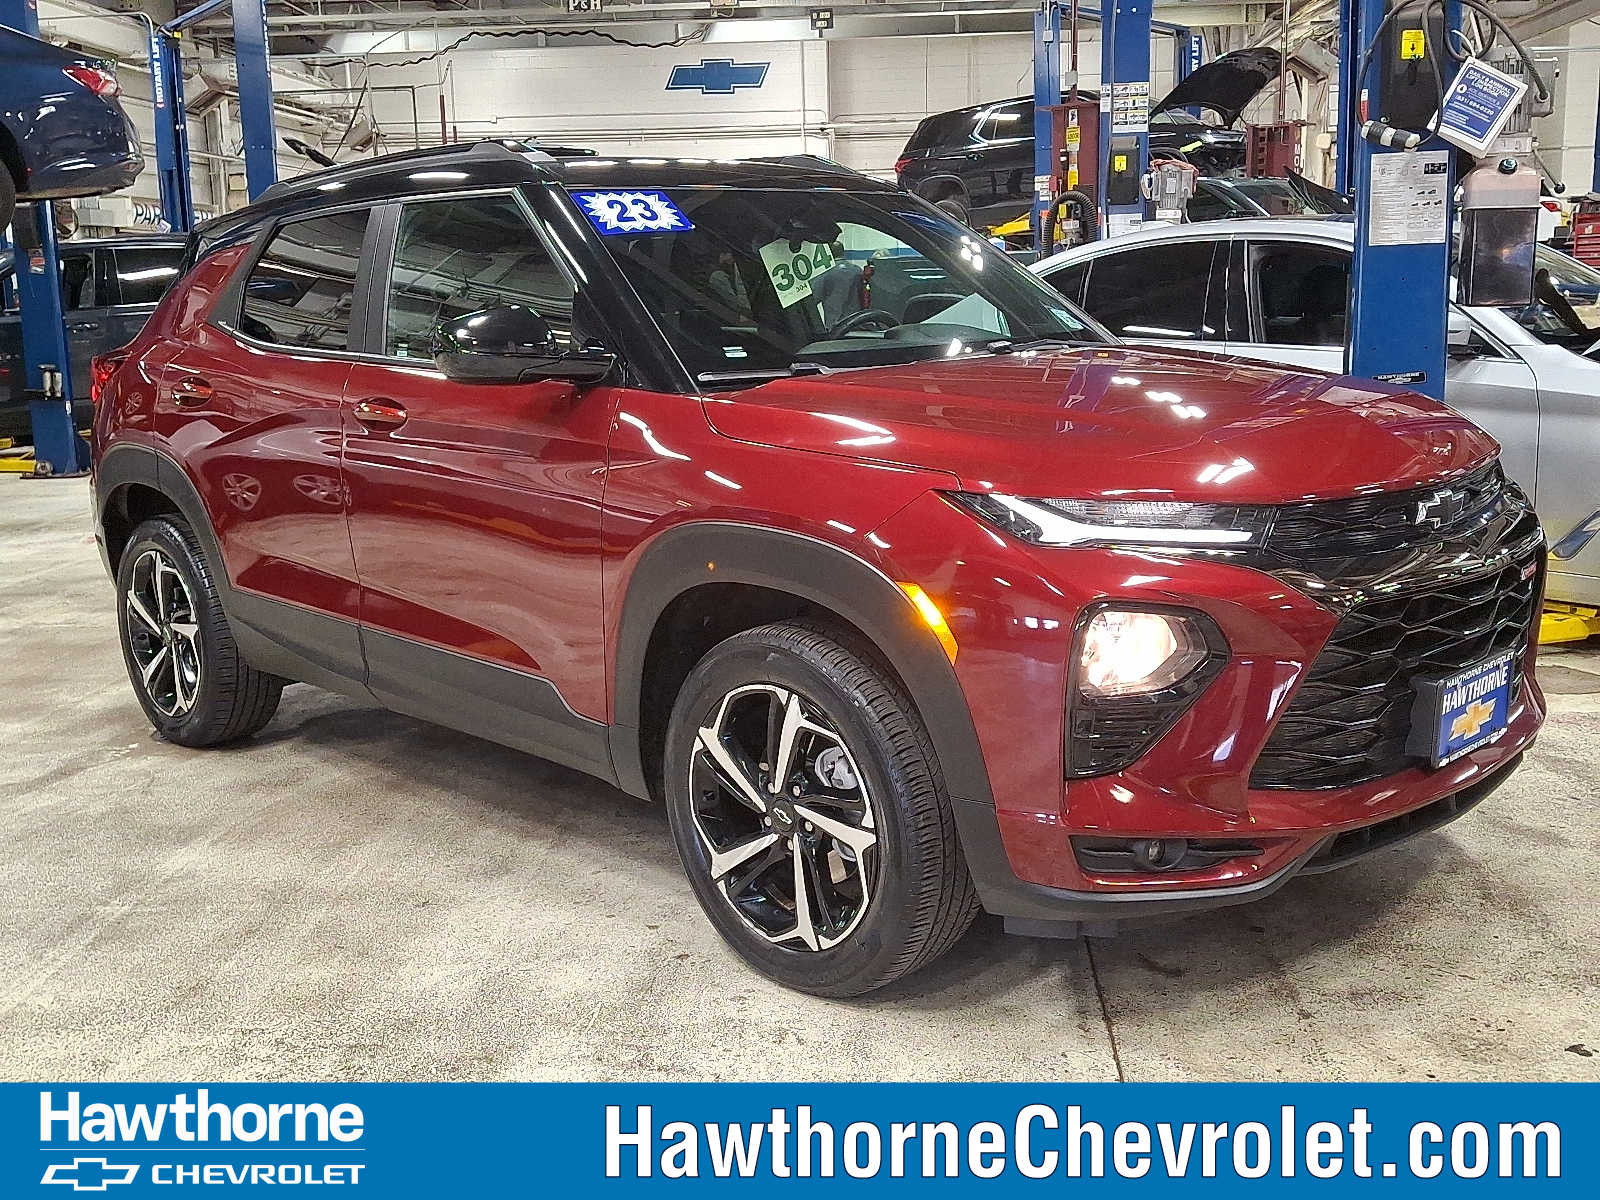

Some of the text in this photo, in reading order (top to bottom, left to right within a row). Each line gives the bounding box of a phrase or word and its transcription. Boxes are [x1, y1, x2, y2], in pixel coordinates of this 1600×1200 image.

[1191, 36, 1200, 57] LIFT
[151, 38, 164, 102] ROTARY LIFT
[133, 203, 161, 225] PAR
[606, 199, 659, 222] 23
[772, 245, 833, 291] 304
[1446, 666, 1483, 689] HAWTHORNE
[1442, 665, 1509, 715] HAWTHORNE
